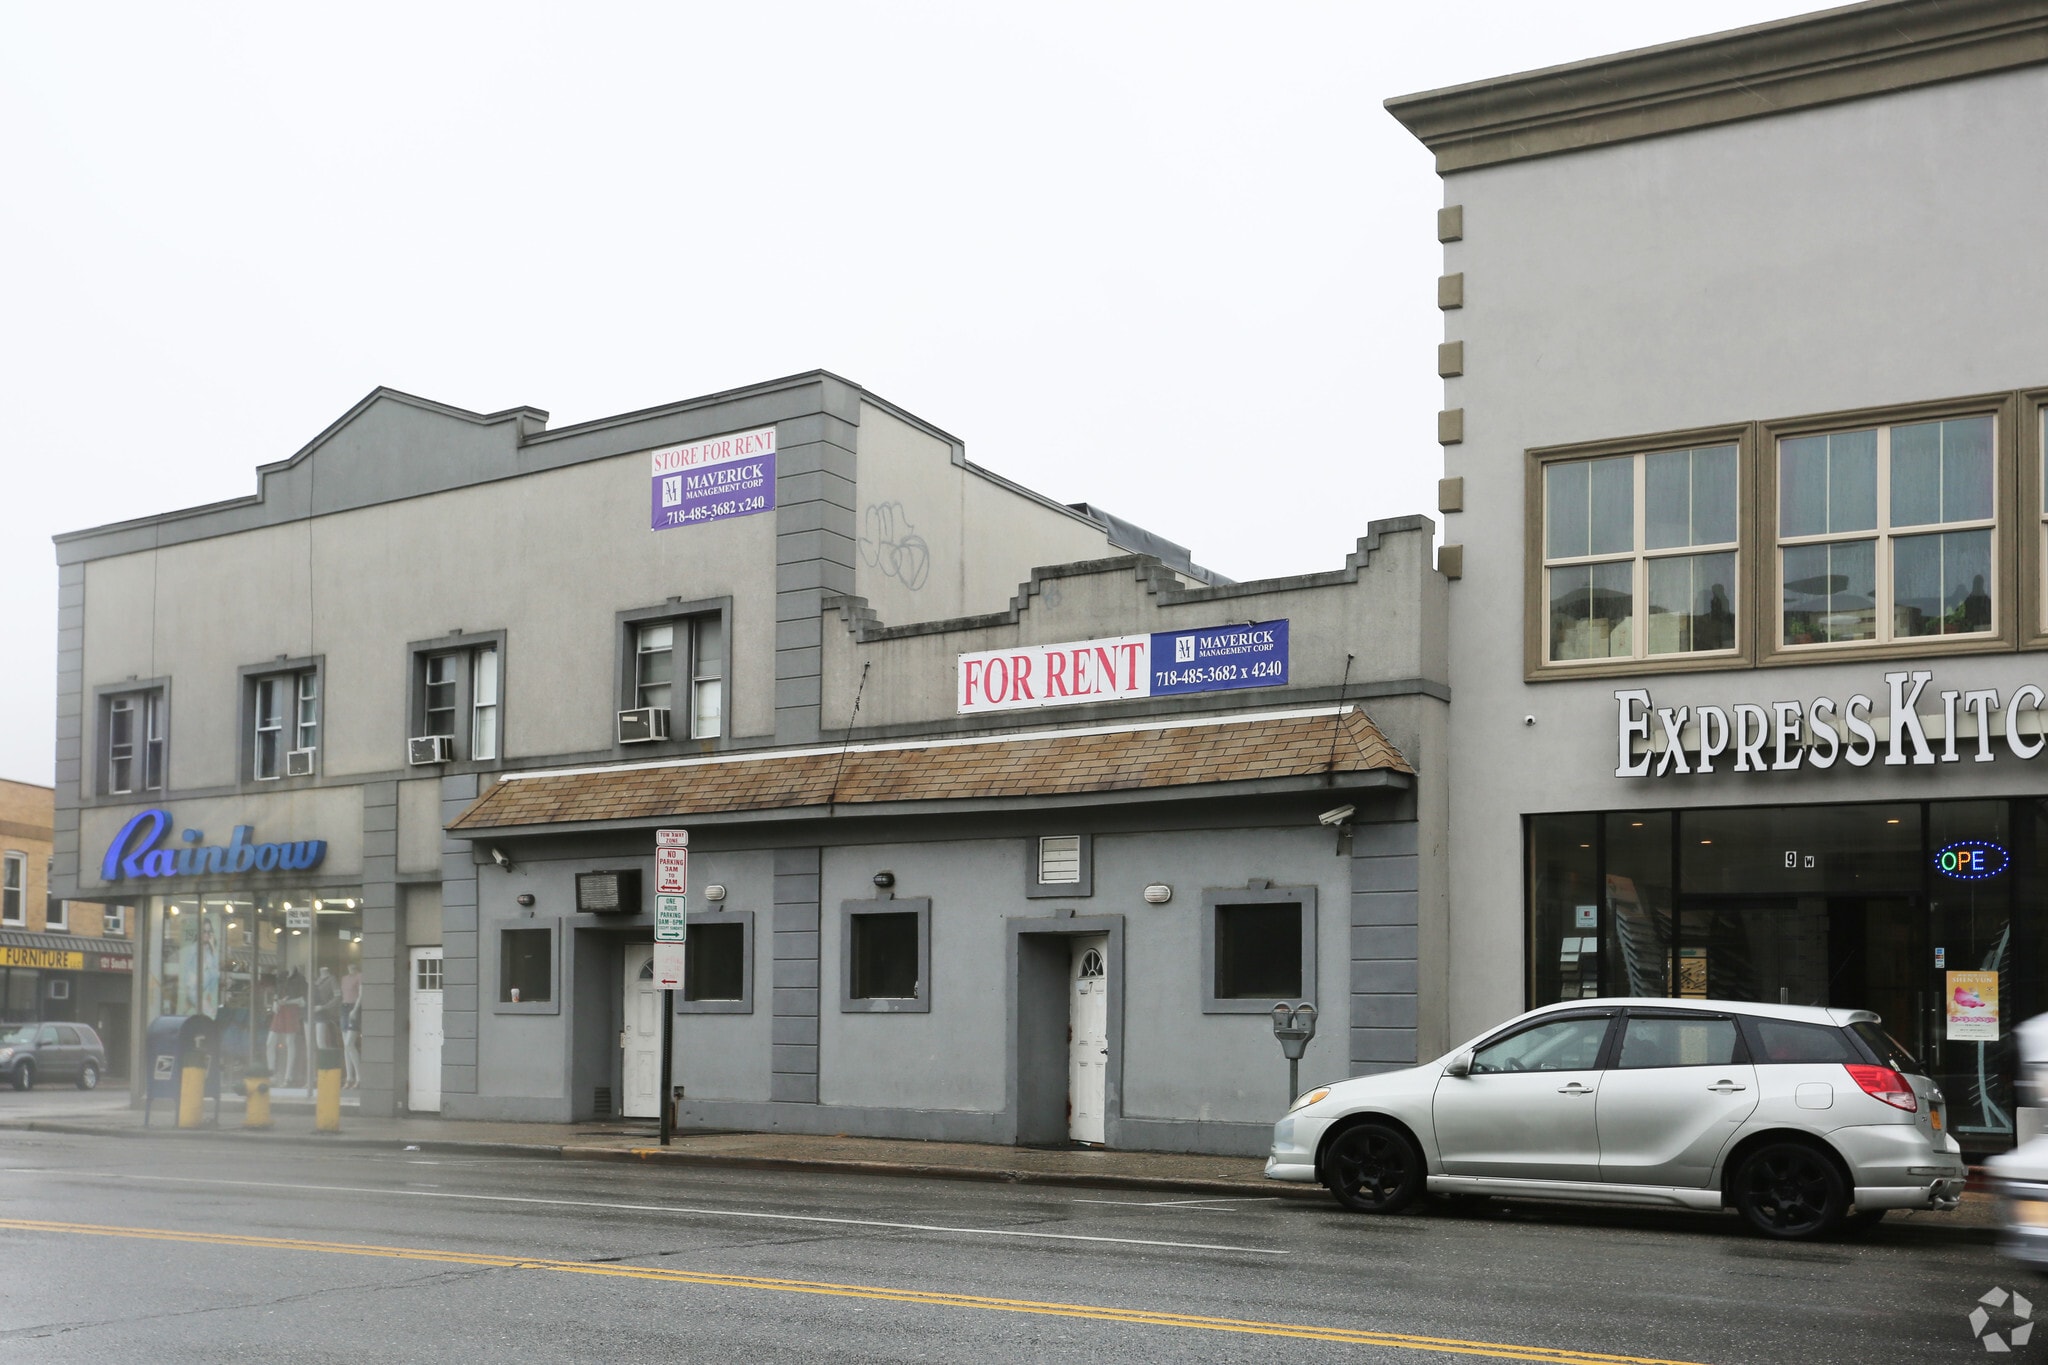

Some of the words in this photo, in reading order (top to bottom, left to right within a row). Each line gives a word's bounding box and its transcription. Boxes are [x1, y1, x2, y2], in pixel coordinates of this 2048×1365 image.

[654, 447, 699, 472] STORE
[702, 440, 731, 462] FOR
[735, 431, 774, 456] RENT
[686, 463, 764, 491] MAVERICK
[686, 483, 741, 500] MANAGEMENT
[742, 479, 764, 490] CORP
[667, 500, 736, 525] 718-485-3682
[1199, 630, 1274, 650] MAVERICK
[1199, 646, 1252, 658] MANAGEMENT
[1253, 643, 1274, 652] CORP
[962, 654, 1035, 706] FOR
[1043, 642, 1145, 699] RENT
[1156, 664, 1237, 687] 718-485-3682
[1240, 667, 1248, 679] x
[1251, 660, 1282, 678] 4240
[101, 808, 328, 881] Rainbow
[667, 850, 677, 858] NO
[660, 858, 684, 866] PARKING
[1786, 852, 1796, 867] 9
[660, 911, 682, 919] PARKING
[6, 948, 69, 967] FURNITURE
